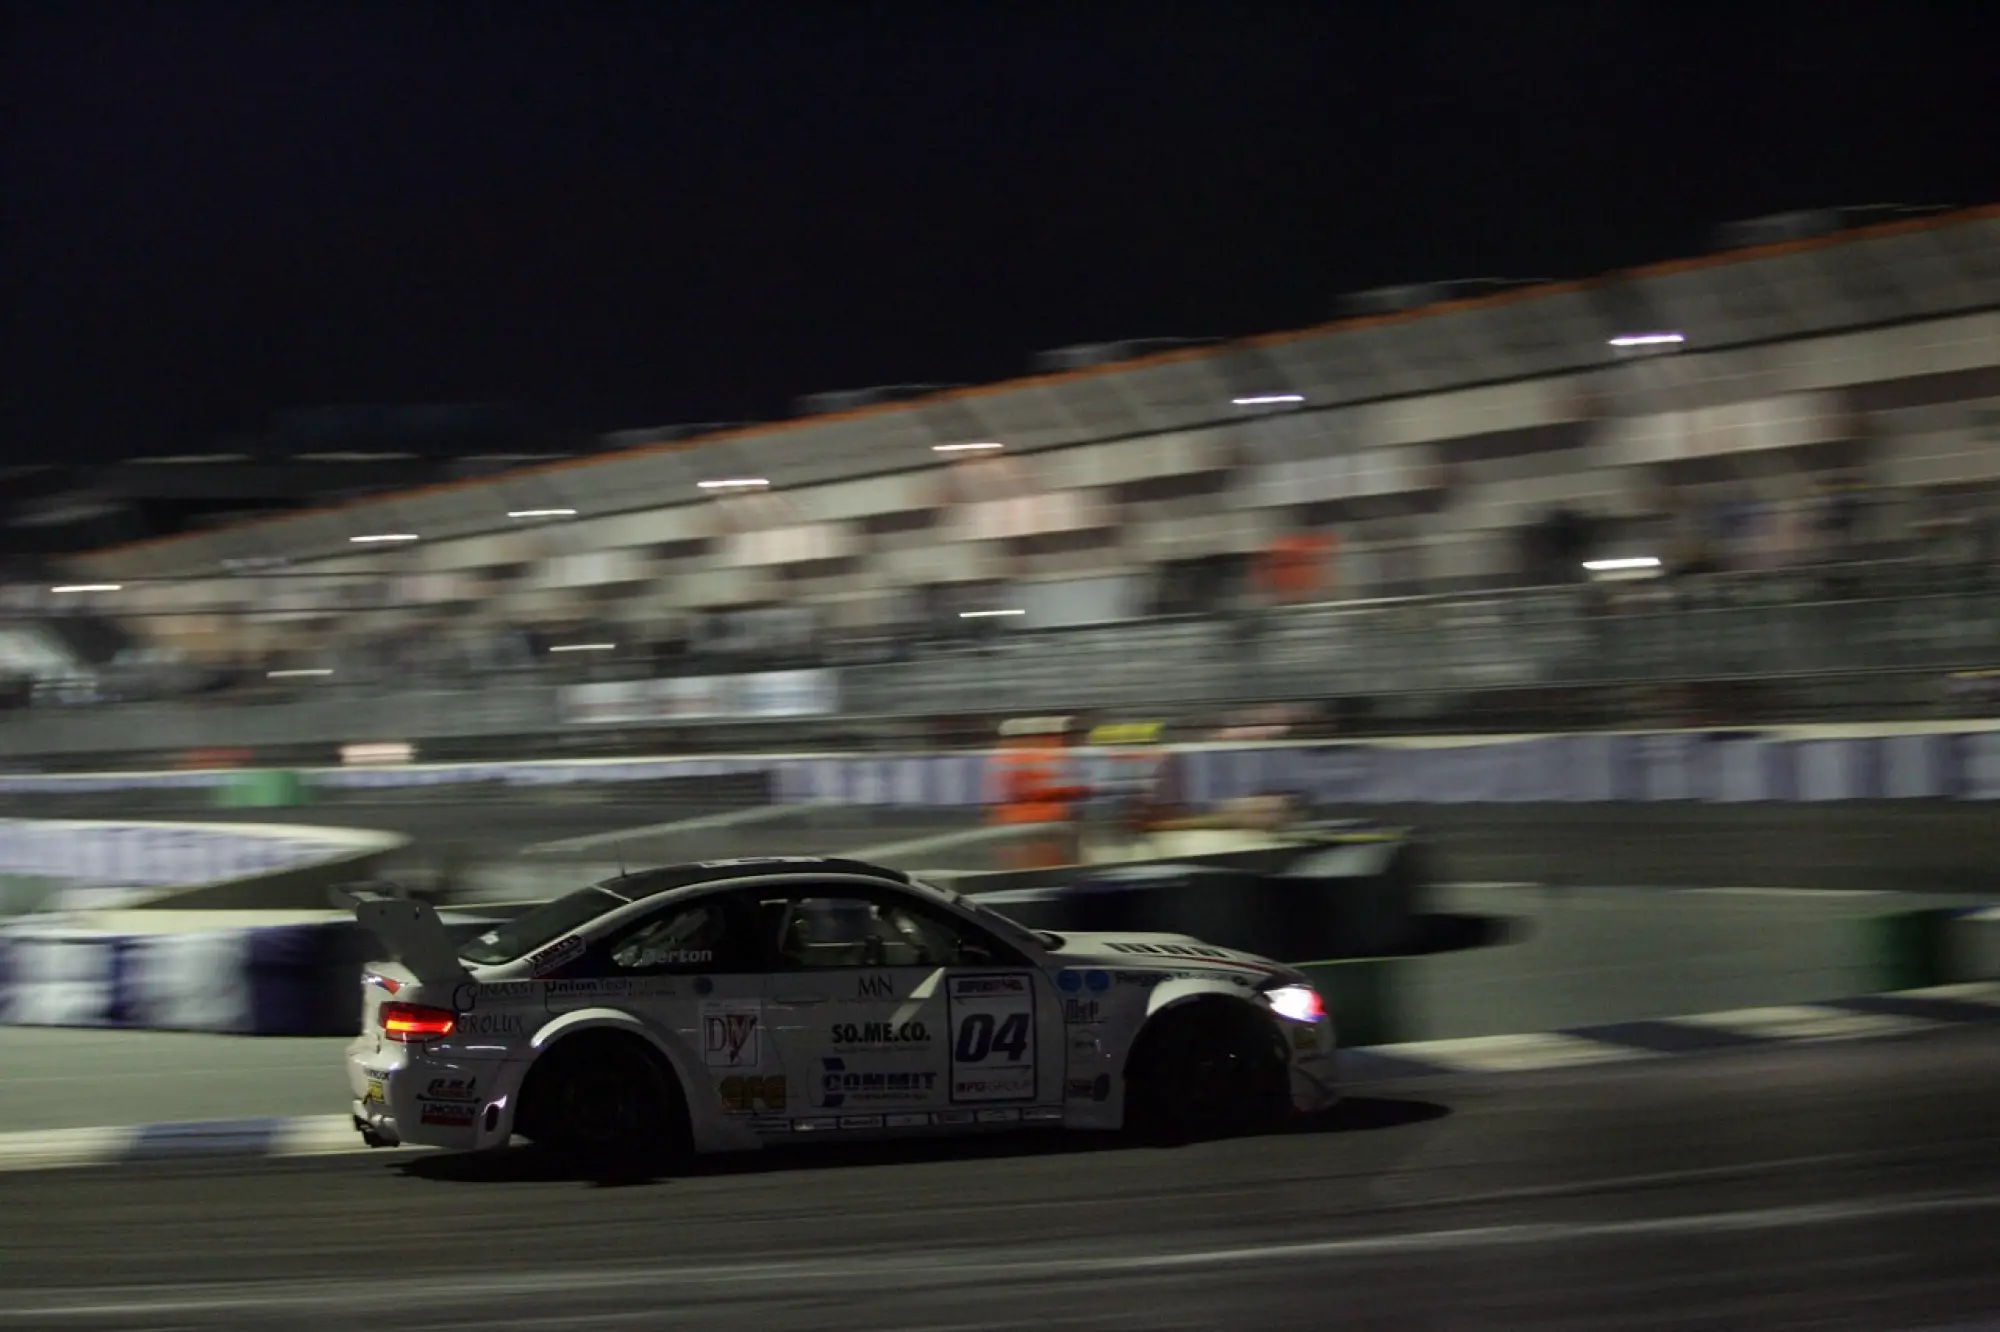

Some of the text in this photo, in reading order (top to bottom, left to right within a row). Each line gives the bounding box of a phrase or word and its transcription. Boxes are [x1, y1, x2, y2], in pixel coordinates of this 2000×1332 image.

[858, 974, 894, 997] MN
[832, 1021, 931, 1044] SO.ME.CO.
[955, 1012, 1030, 1063] 04
[822, 1071, 938, 1092] COMMIT
